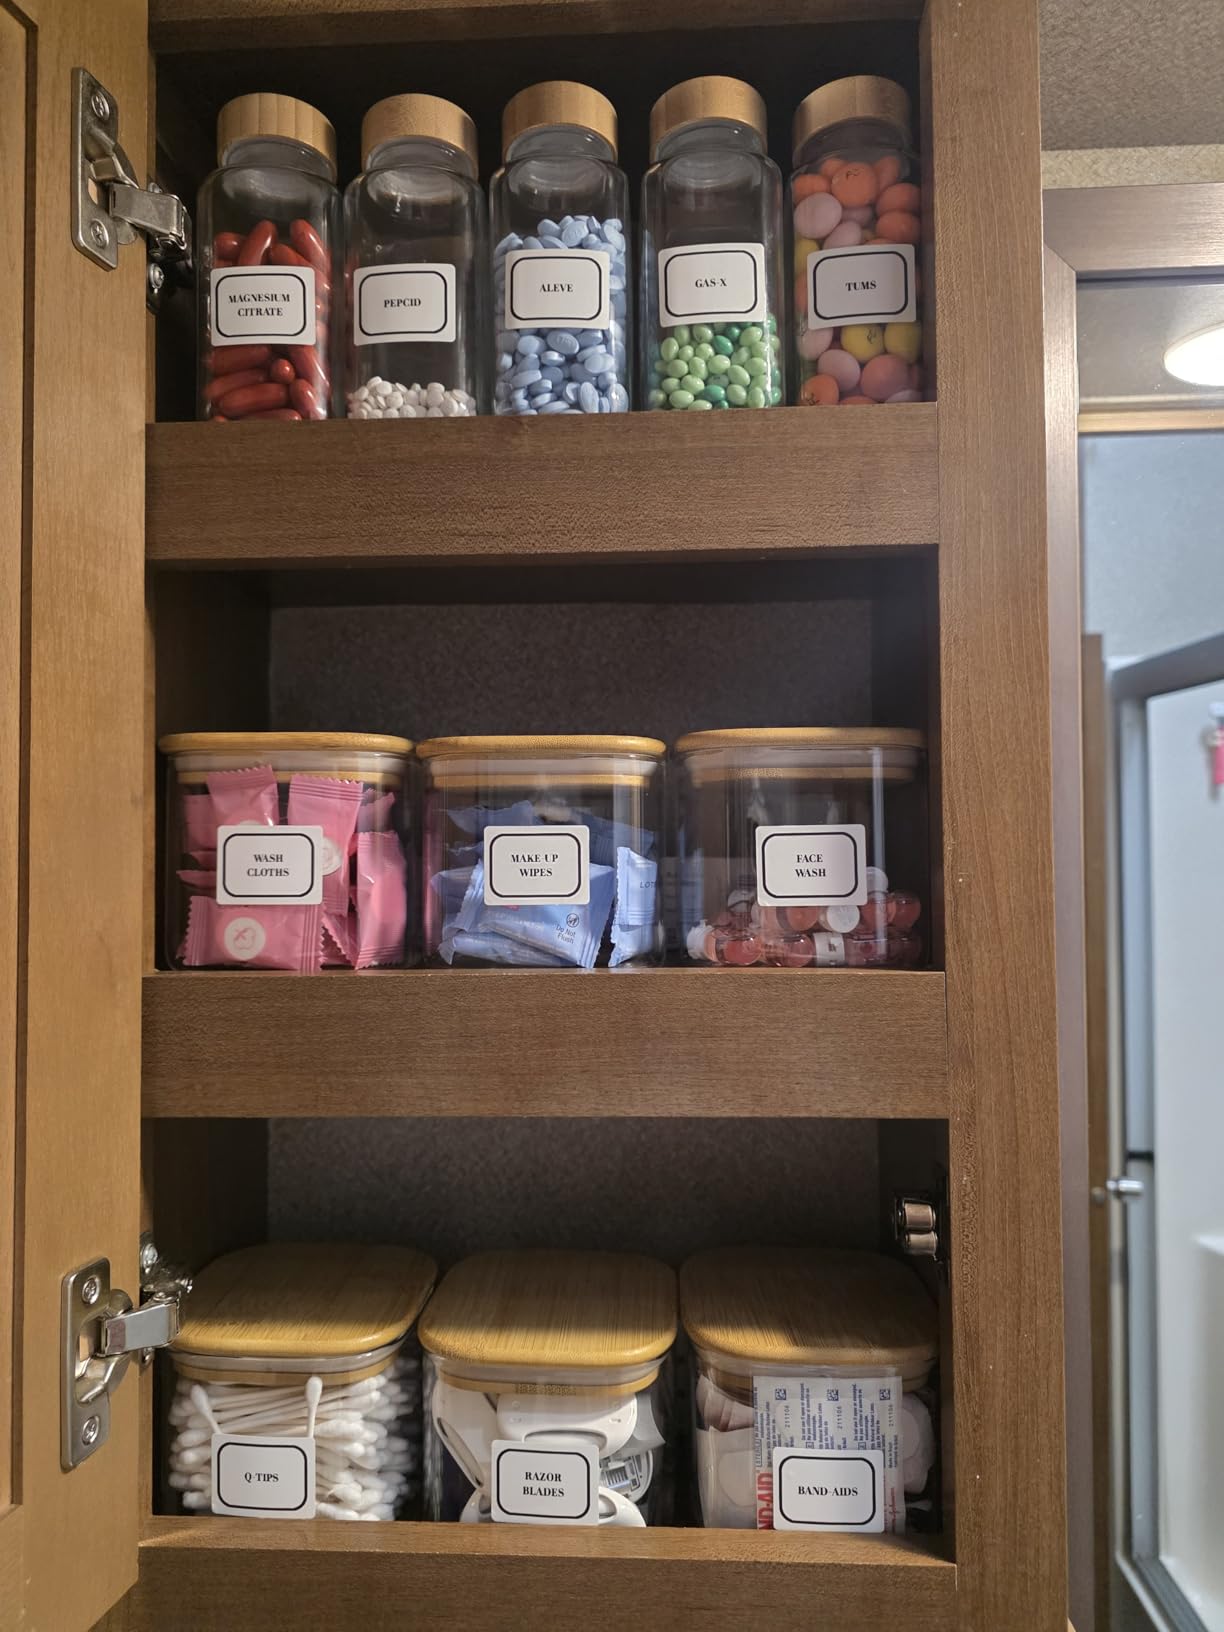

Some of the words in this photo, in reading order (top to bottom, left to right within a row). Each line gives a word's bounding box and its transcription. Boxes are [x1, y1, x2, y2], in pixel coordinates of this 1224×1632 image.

[694, 278, 728, 288] GAS-X
[845, 281, 877, 291] TUMS
[539, 284, 574, 292] ALEVE
[227, 293, 291, 304] MAGNESIUM
[383, 299, 422, 308] PEPCID
[236, 308, 283, 317] CITRATE
[253, 854, 284, 862] WASH
[510, 854, 559, 862] MAKE-UP
[796, 854, 824, 863] FACE
[246, 868, 290, 876] CLOTHS
[519, 869, 553, 877] WIPES
[794, 868, 827, 877] WASH
[556, 924, 563, 932] Do
[566, 929, 576, 937] Not
[557, 934, 574, 944] Flush
[243, 1472, 280, 1483] Q-TIPS
[524, 1472, 562, 1482] RAZOR
[522, 1486, 565, 1497] BLADES
[797, 1486, 859, 1496] BAND-AIDS
